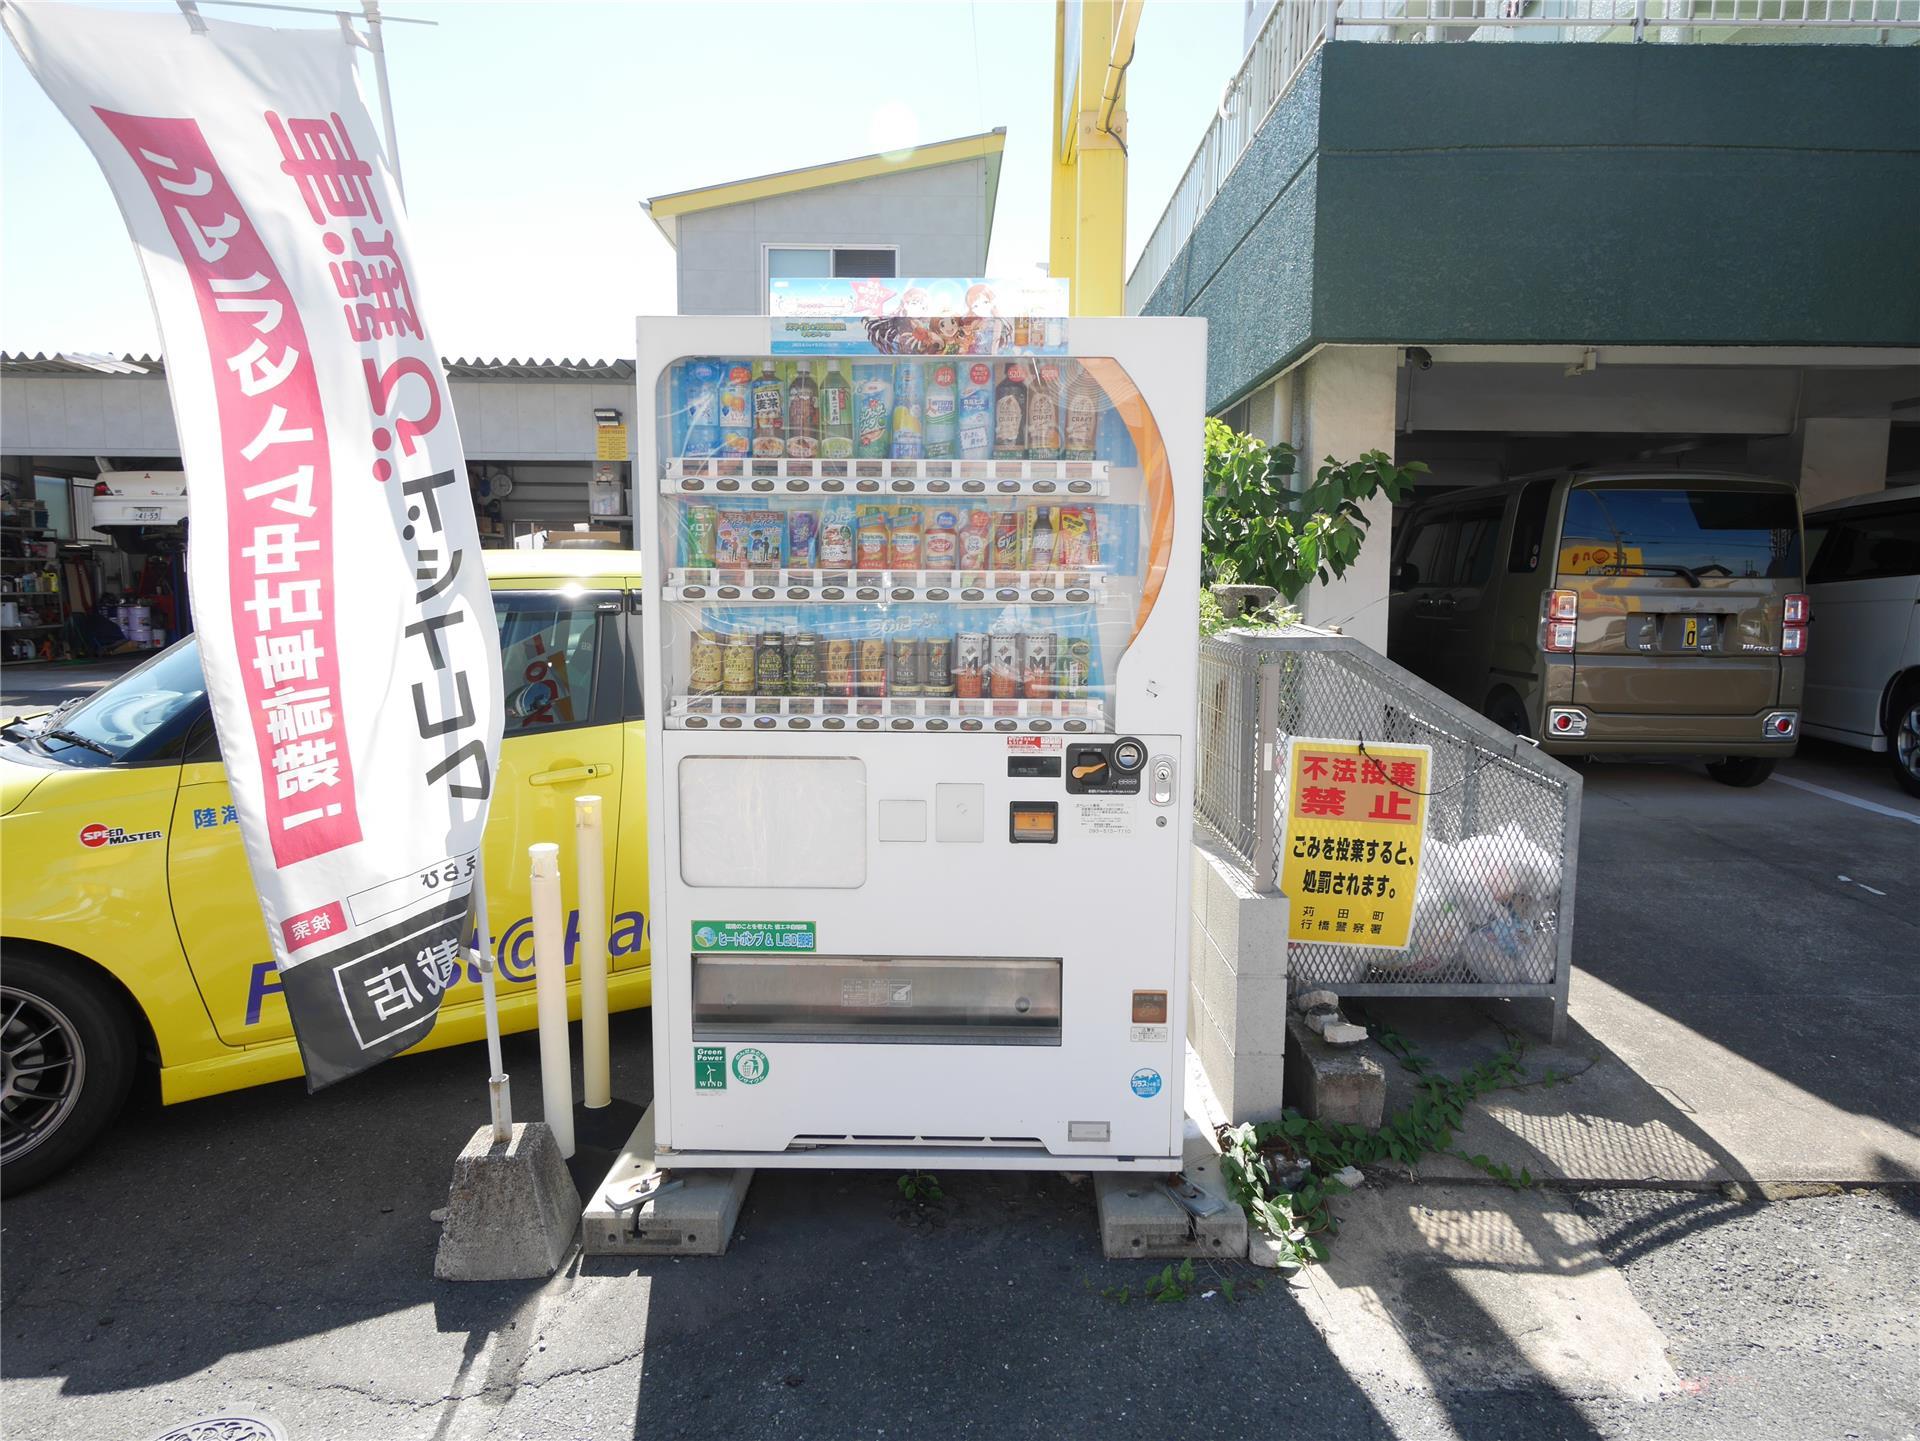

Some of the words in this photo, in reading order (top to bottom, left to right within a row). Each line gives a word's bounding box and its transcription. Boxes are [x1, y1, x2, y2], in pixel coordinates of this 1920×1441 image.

[756, 398, 779, 409] 麦茶
[1302, 755, 1416, 787] 不法投棄
[1300, 786, 1411, 820] 禁止
[83, 827, 124, 841] SPEED
[109, 830, 163, 846] MASTER
[1293, 835, 1415, 866] ごみを投棄すると、
[1302, 869, 1396, 899] 処罰されます。
[1302, 906, 1385, 922] 苅田町
[1301, 919, 1383, 935] 行橋警察署
[718, 931, 764, 947] ヒートポンプ
[764, 933, 774, 946] &
